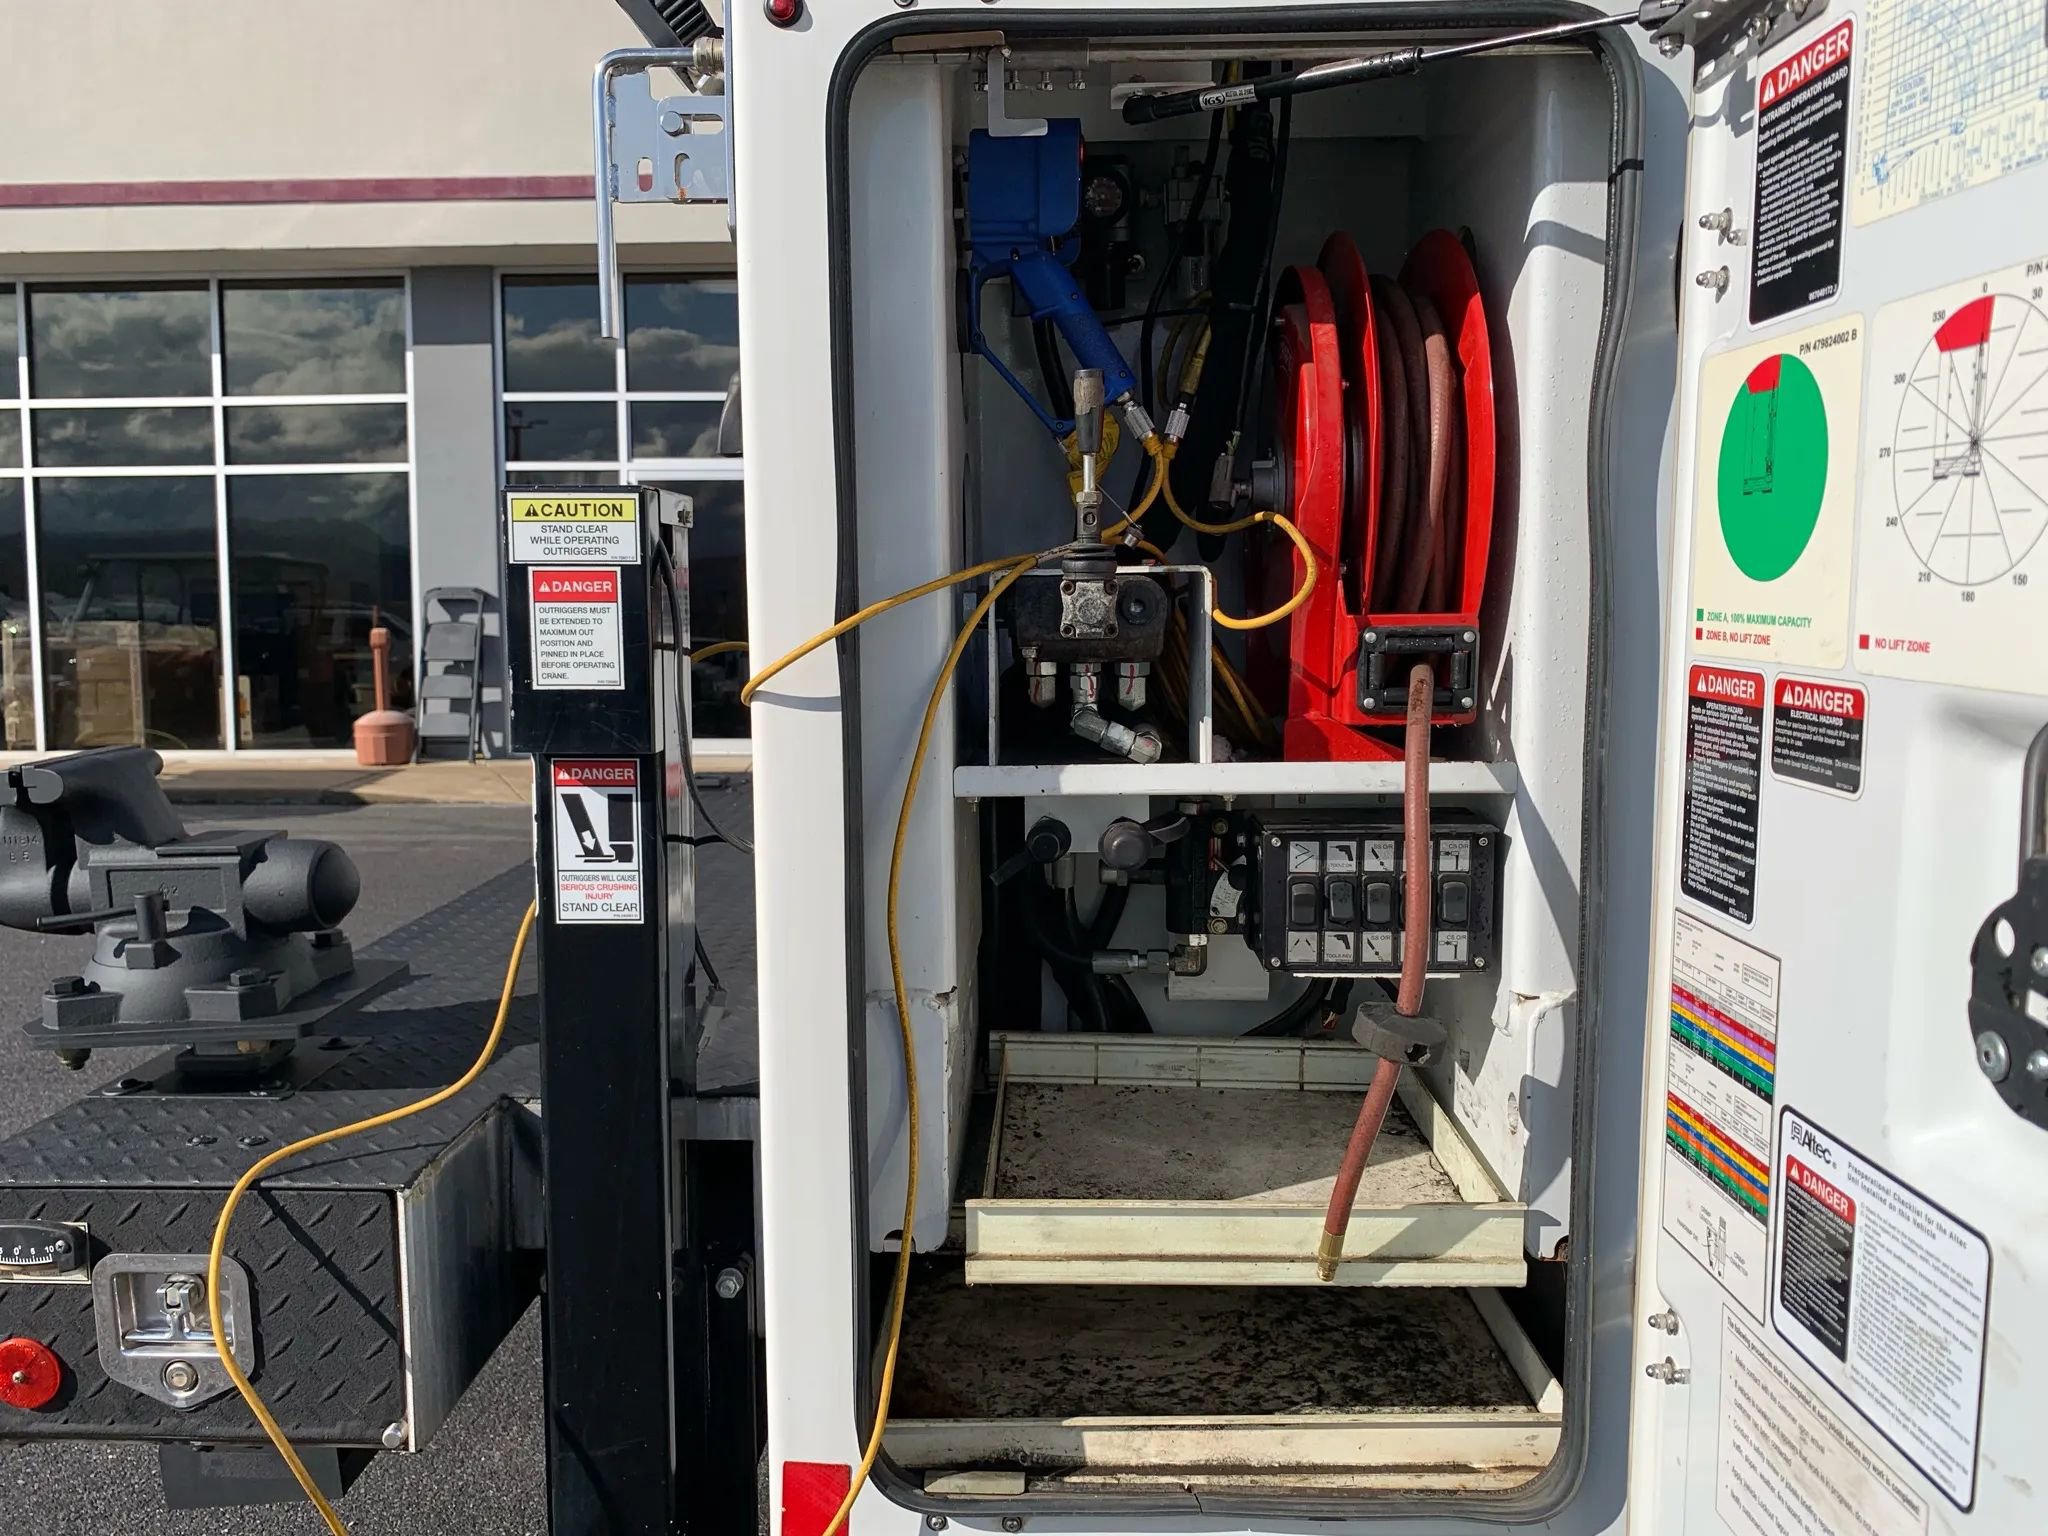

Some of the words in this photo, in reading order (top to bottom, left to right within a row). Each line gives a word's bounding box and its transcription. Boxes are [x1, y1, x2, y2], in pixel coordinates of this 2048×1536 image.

[1778, 28, 1849, 95] DANGER
[1204, 95, 1222, 105] IGS
[1760, 102, 1790, 127] UNTRAINED
[1792, 83, 1822, 106] OPERATOR
[1822, 66, 1848, 89] HAZARD
[2026, 260, 2043, 277] P/N
[1983, 282, 1988, 293] 0
[2032, 286, 2043, 300] 30
[1932, 310, 1946, 322] 330
[1894, 373, 1906, 385] 300
[1879, 446, 1891, 458] 270
[541, 503, 622, 517] CAUTION
[1886, 517, 1898, 527] 240
[540, 524, 572, 533] STAND
[575, 524, 607, 533] CLEAR
[530, 535, 560, 544] WHILE
[563, 535, 619, 544] OPERATING
[542, 546, 607, 555] OUTRIGGERS
[1918, 572, 1931, 582] 210
[2013, 574, 2027, 586] 150
[552, 581, 612, 592] DANGER
[1961, 592, 1975, 602] 180
[1706, 611, 1722, 622] ZONE
[1722, 612, 1728, 622] A,
[1730, 612, 1744, 623] 100%
[1746, 614, 1776, 625] MAXIMUM
[1777, 615, 1811, 627] CAPACITY
[1706, 629, 1721, 640] ZONE
[1722, 631, 1728, 642] B,
[1729, 632, 1738, 642] NO
[1739, 633, 1752, 643] LIFT
[1752, 634, 1770, 645] ZONE
[1875, 638, 1886, 649] NO
[1889, 639, 1905, 651] LIFT
[1907, 641, 1930, 653] ZONE
[1708, 675, 1755, 698] DANGER
[1794, 686, 1853, 714] DANGER
[1706, 701, 1726, 711] OPERATING
[1727, 706, 1743, 714] HAZARD
[1790, 709, 1818, 721] ELECTRICAL
[1819, 714, 1842, 726] HAZARDS
[572, 768, 634, 780] DANGER
[561, 883, 594, 891] SERIOUS
[596, 883, 638, 891] CRUSHING
[562, 903, 598, 912] STAND
[601, 903, 638, 912] CLEAR
[1802, 1130, 1832, 1164] Altec
[1804, 1170, 1848, 1212] DANGER
[1847, 1161, 1891, 1196] Preoperational
[1892, 1192, 1922, 1218] Checklist
[1924, 1213, 1934, 1225] for
[1936, 1222, 1946, 1235] the
[1948, 1231, 1966, 1248] Altec
[1847, 1172, 1859, 1185] Unit
[1860, 1181, 1886, 1205] Installed
[1888, 1202, 1896, 1211] on
[1898, 1207, 1910, 1221] this
[1912, 1217, 1936, 1240] Vehicle
